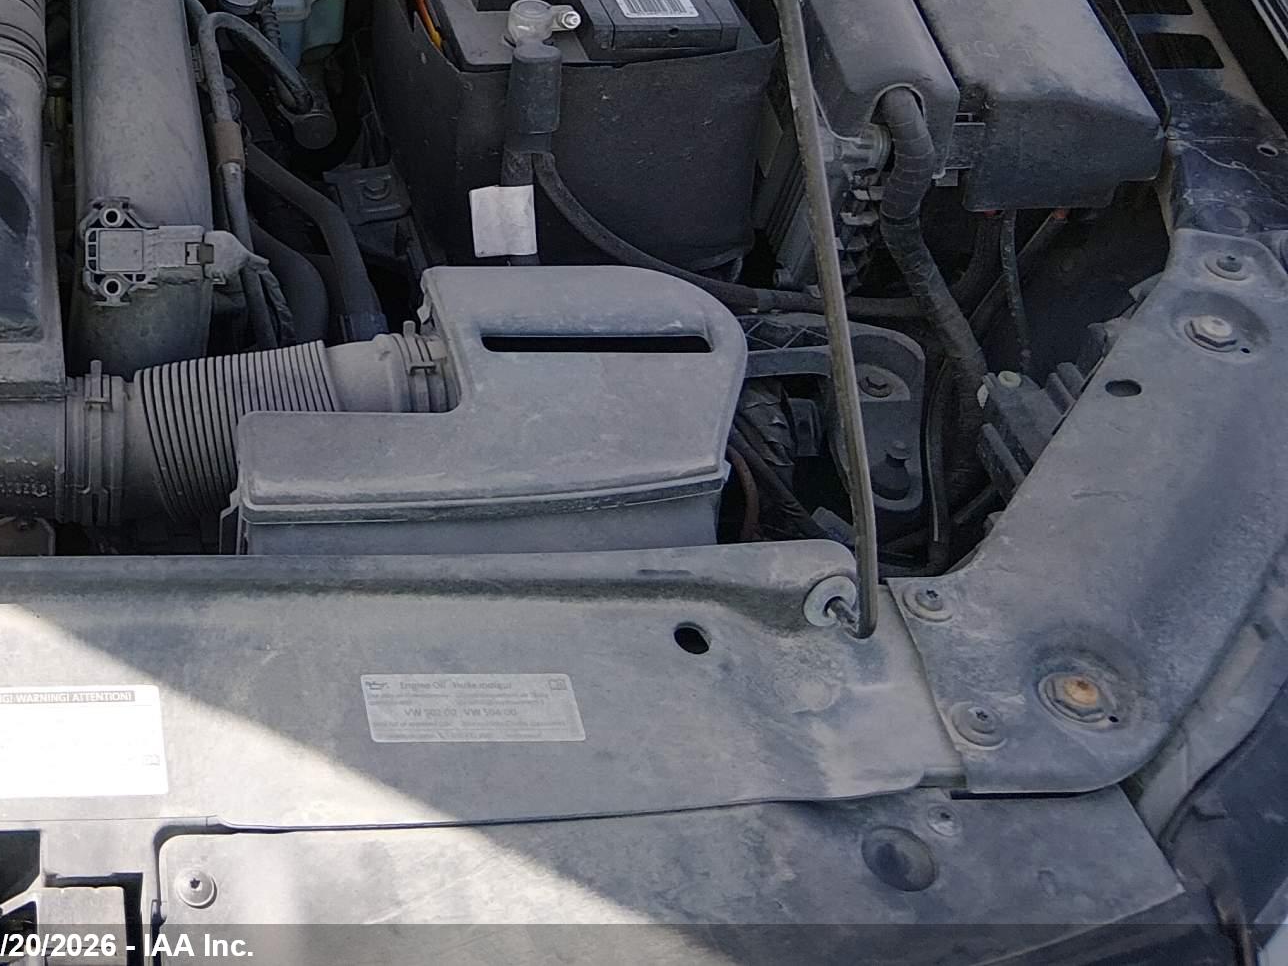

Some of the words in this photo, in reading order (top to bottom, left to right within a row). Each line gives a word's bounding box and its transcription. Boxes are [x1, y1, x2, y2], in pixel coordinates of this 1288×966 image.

[16, 693, 70, 703] WARNING!
[72, 691, 132, 702] ATTENTION!
[404, 708, 421, 717] VW
[464, 708, 481, 716] VW
